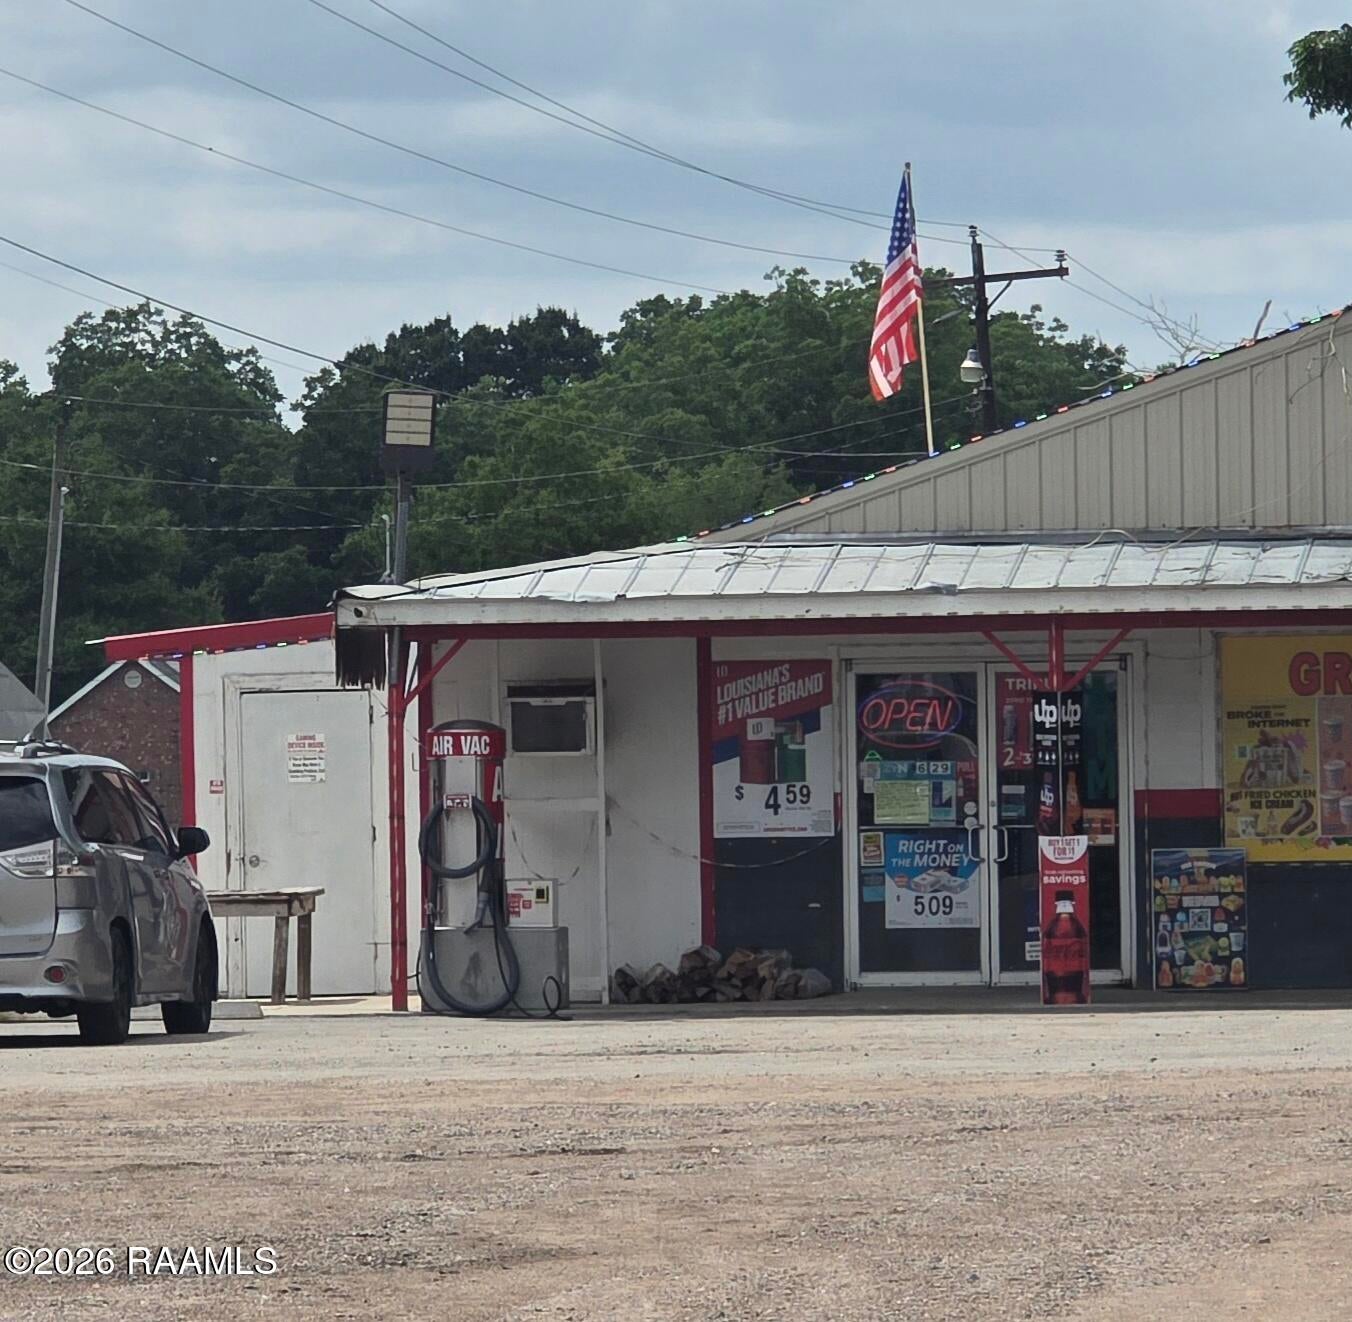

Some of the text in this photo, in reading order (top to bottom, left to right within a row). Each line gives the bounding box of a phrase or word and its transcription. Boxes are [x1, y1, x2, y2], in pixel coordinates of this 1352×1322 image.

[716, 663, 790, 705] LOUISIANA'S
[717, 672, 824, 727] #1 VALUE BRAND
[862, 698, 952, 732] OPEN
[1227, 711, 1272, 720] BROKE
[1248, 718, 1311, 728] INTERNET
[432, 735, 490, 756] AIR VAC
[735, 784, 812, 816] $ 4 59
[1244, 790, 1271, 800] FRIED
[1272, 789, 1317, 799] CHICKEN
[1266, 799, 1294, 809] CREAM
[898, 839, 964, 853] RIGHT ON
[1053, 847, 1067, 857] FOR
[891, 853, 970, 867] THE MONEY
[1042, 874, 1087, 885] savings
